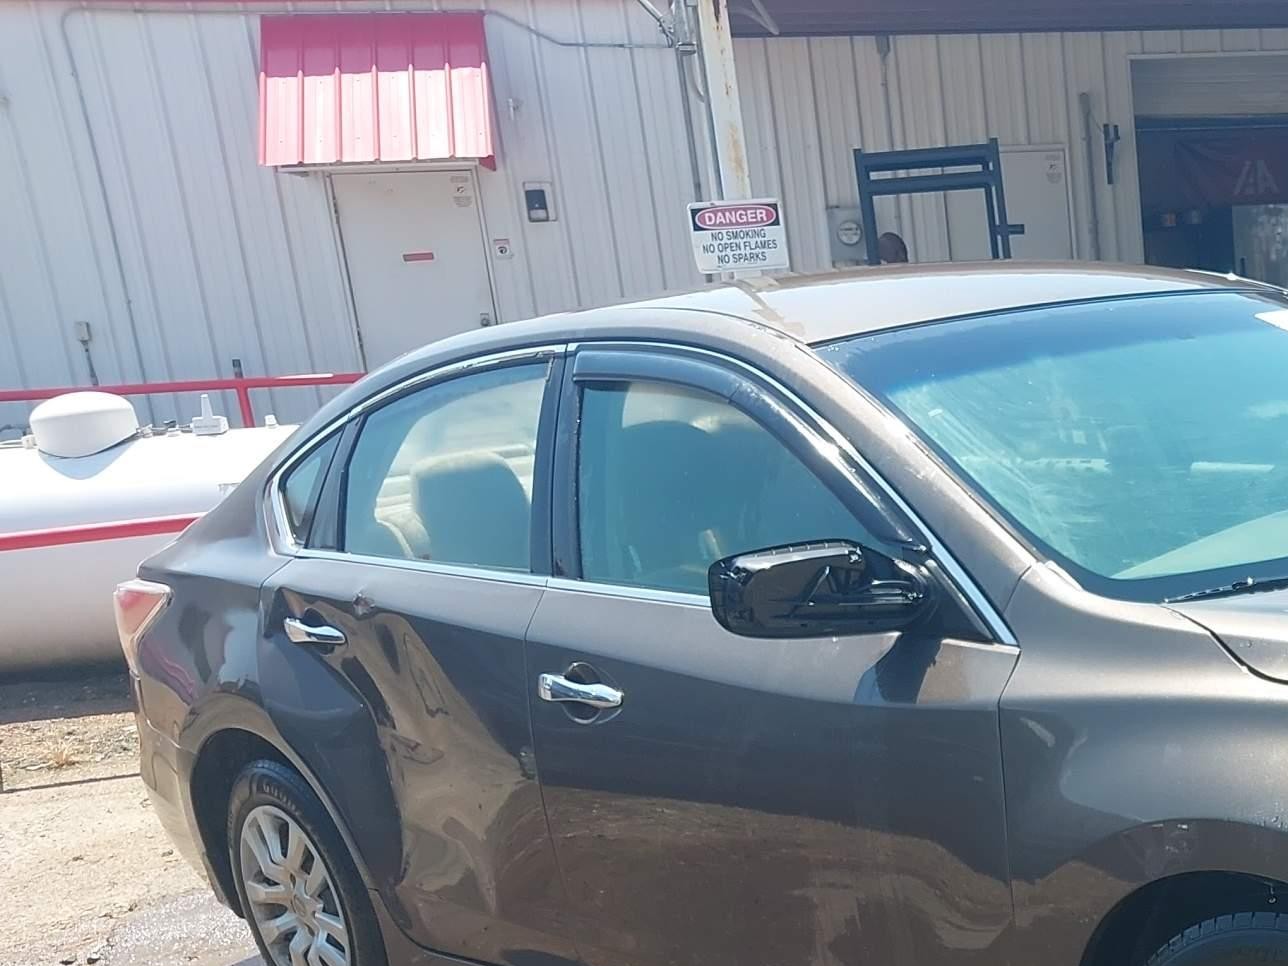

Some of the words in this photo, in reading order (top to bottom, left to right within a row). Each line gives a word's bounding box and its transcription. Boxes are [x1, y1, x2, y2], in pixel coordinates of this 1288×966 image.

[704, 209, 767, 225] DANGER
[711, 231, 724, 241] NO
[726, 228, 766, 240] SMOKING
[702, 244, 715, 254] NO
[717, 241, 741, 252] OPEN
[743, 239, 778, 251] FLAMES
[717, 254, 730, 264] NO
[732, 251, 767, 263] SPARKS
